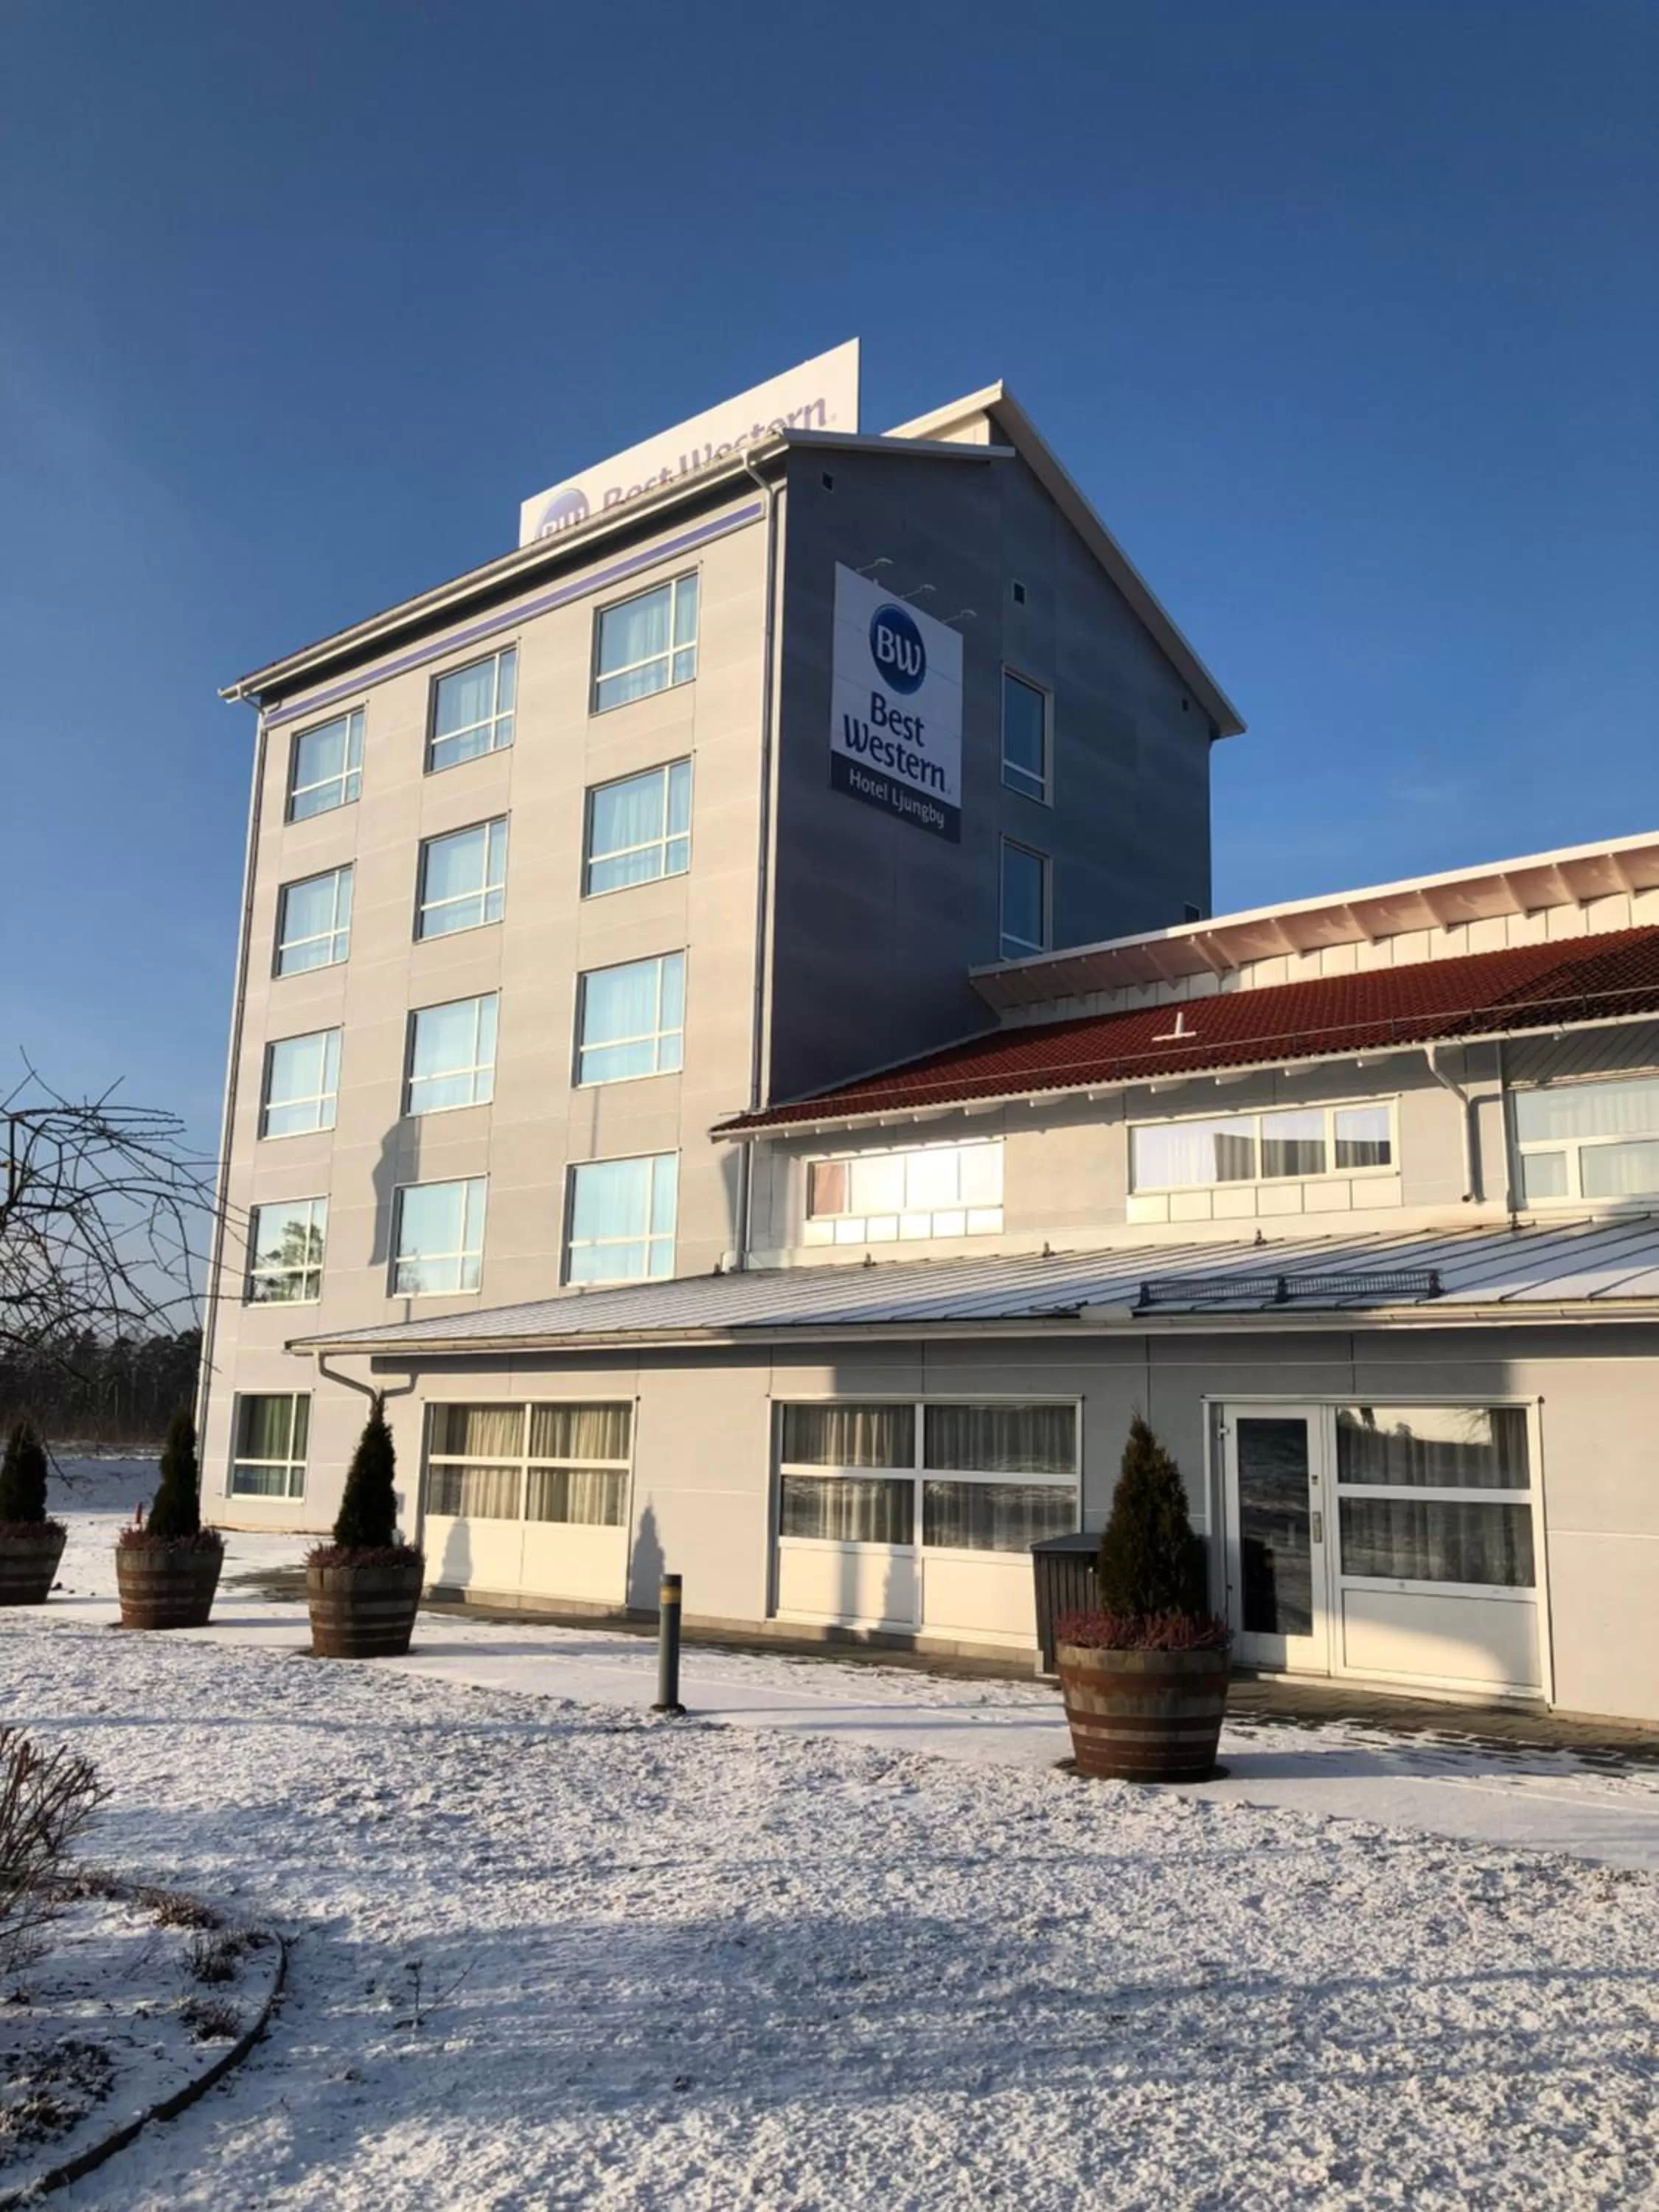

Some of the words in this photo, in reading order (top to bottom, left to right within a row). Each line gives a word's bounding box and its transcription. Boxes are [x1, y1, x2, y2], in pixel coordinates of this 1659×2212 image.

[875, 625, 922, 677] BW
[871, 690, 925, 748] Best
[844, 713, 945, 793] Western
[849, 767, 888, 801] Hotel
[891, 787, 945, 830] Ljungby
